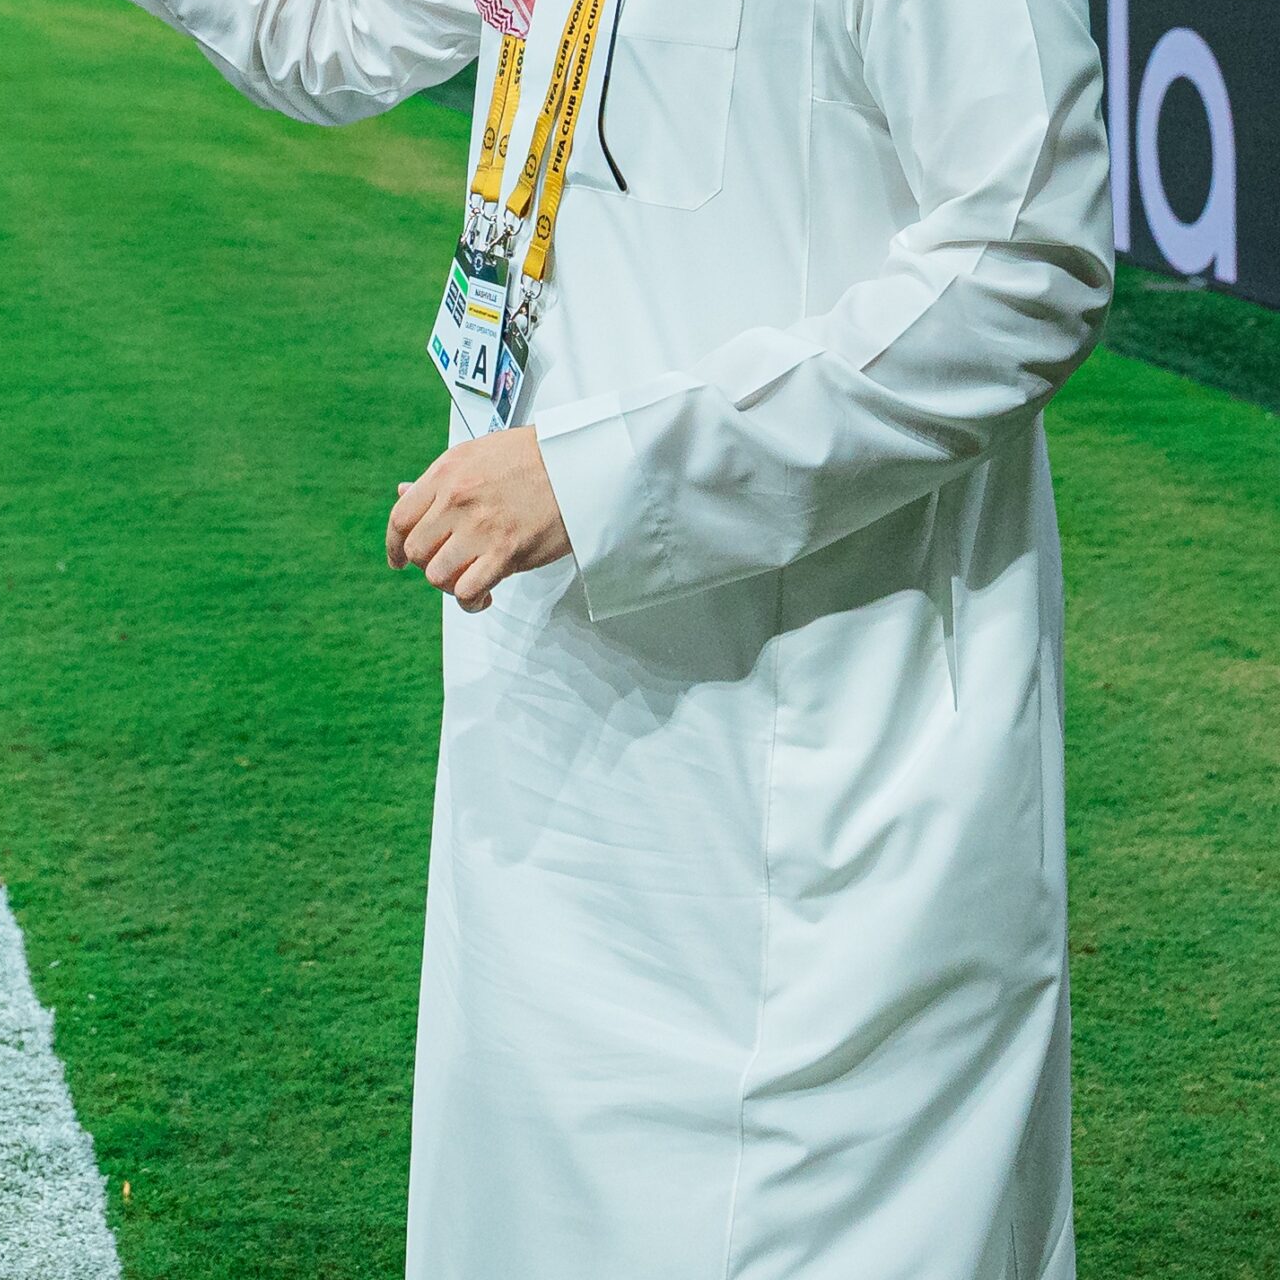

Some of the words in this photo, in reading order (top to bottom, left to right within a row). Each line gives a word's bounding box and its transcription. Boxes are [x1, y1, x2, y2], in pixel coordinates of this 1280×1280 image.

[544, 82, 558, 115] FIFA
[556, 39, 570, 79] CLUB
[552, 139, 566, 173] FIFA
[562, 95, 577, 136] CLUB
[572, 32, 591, 91] WORLD
[472, 344, 487, 384] A
